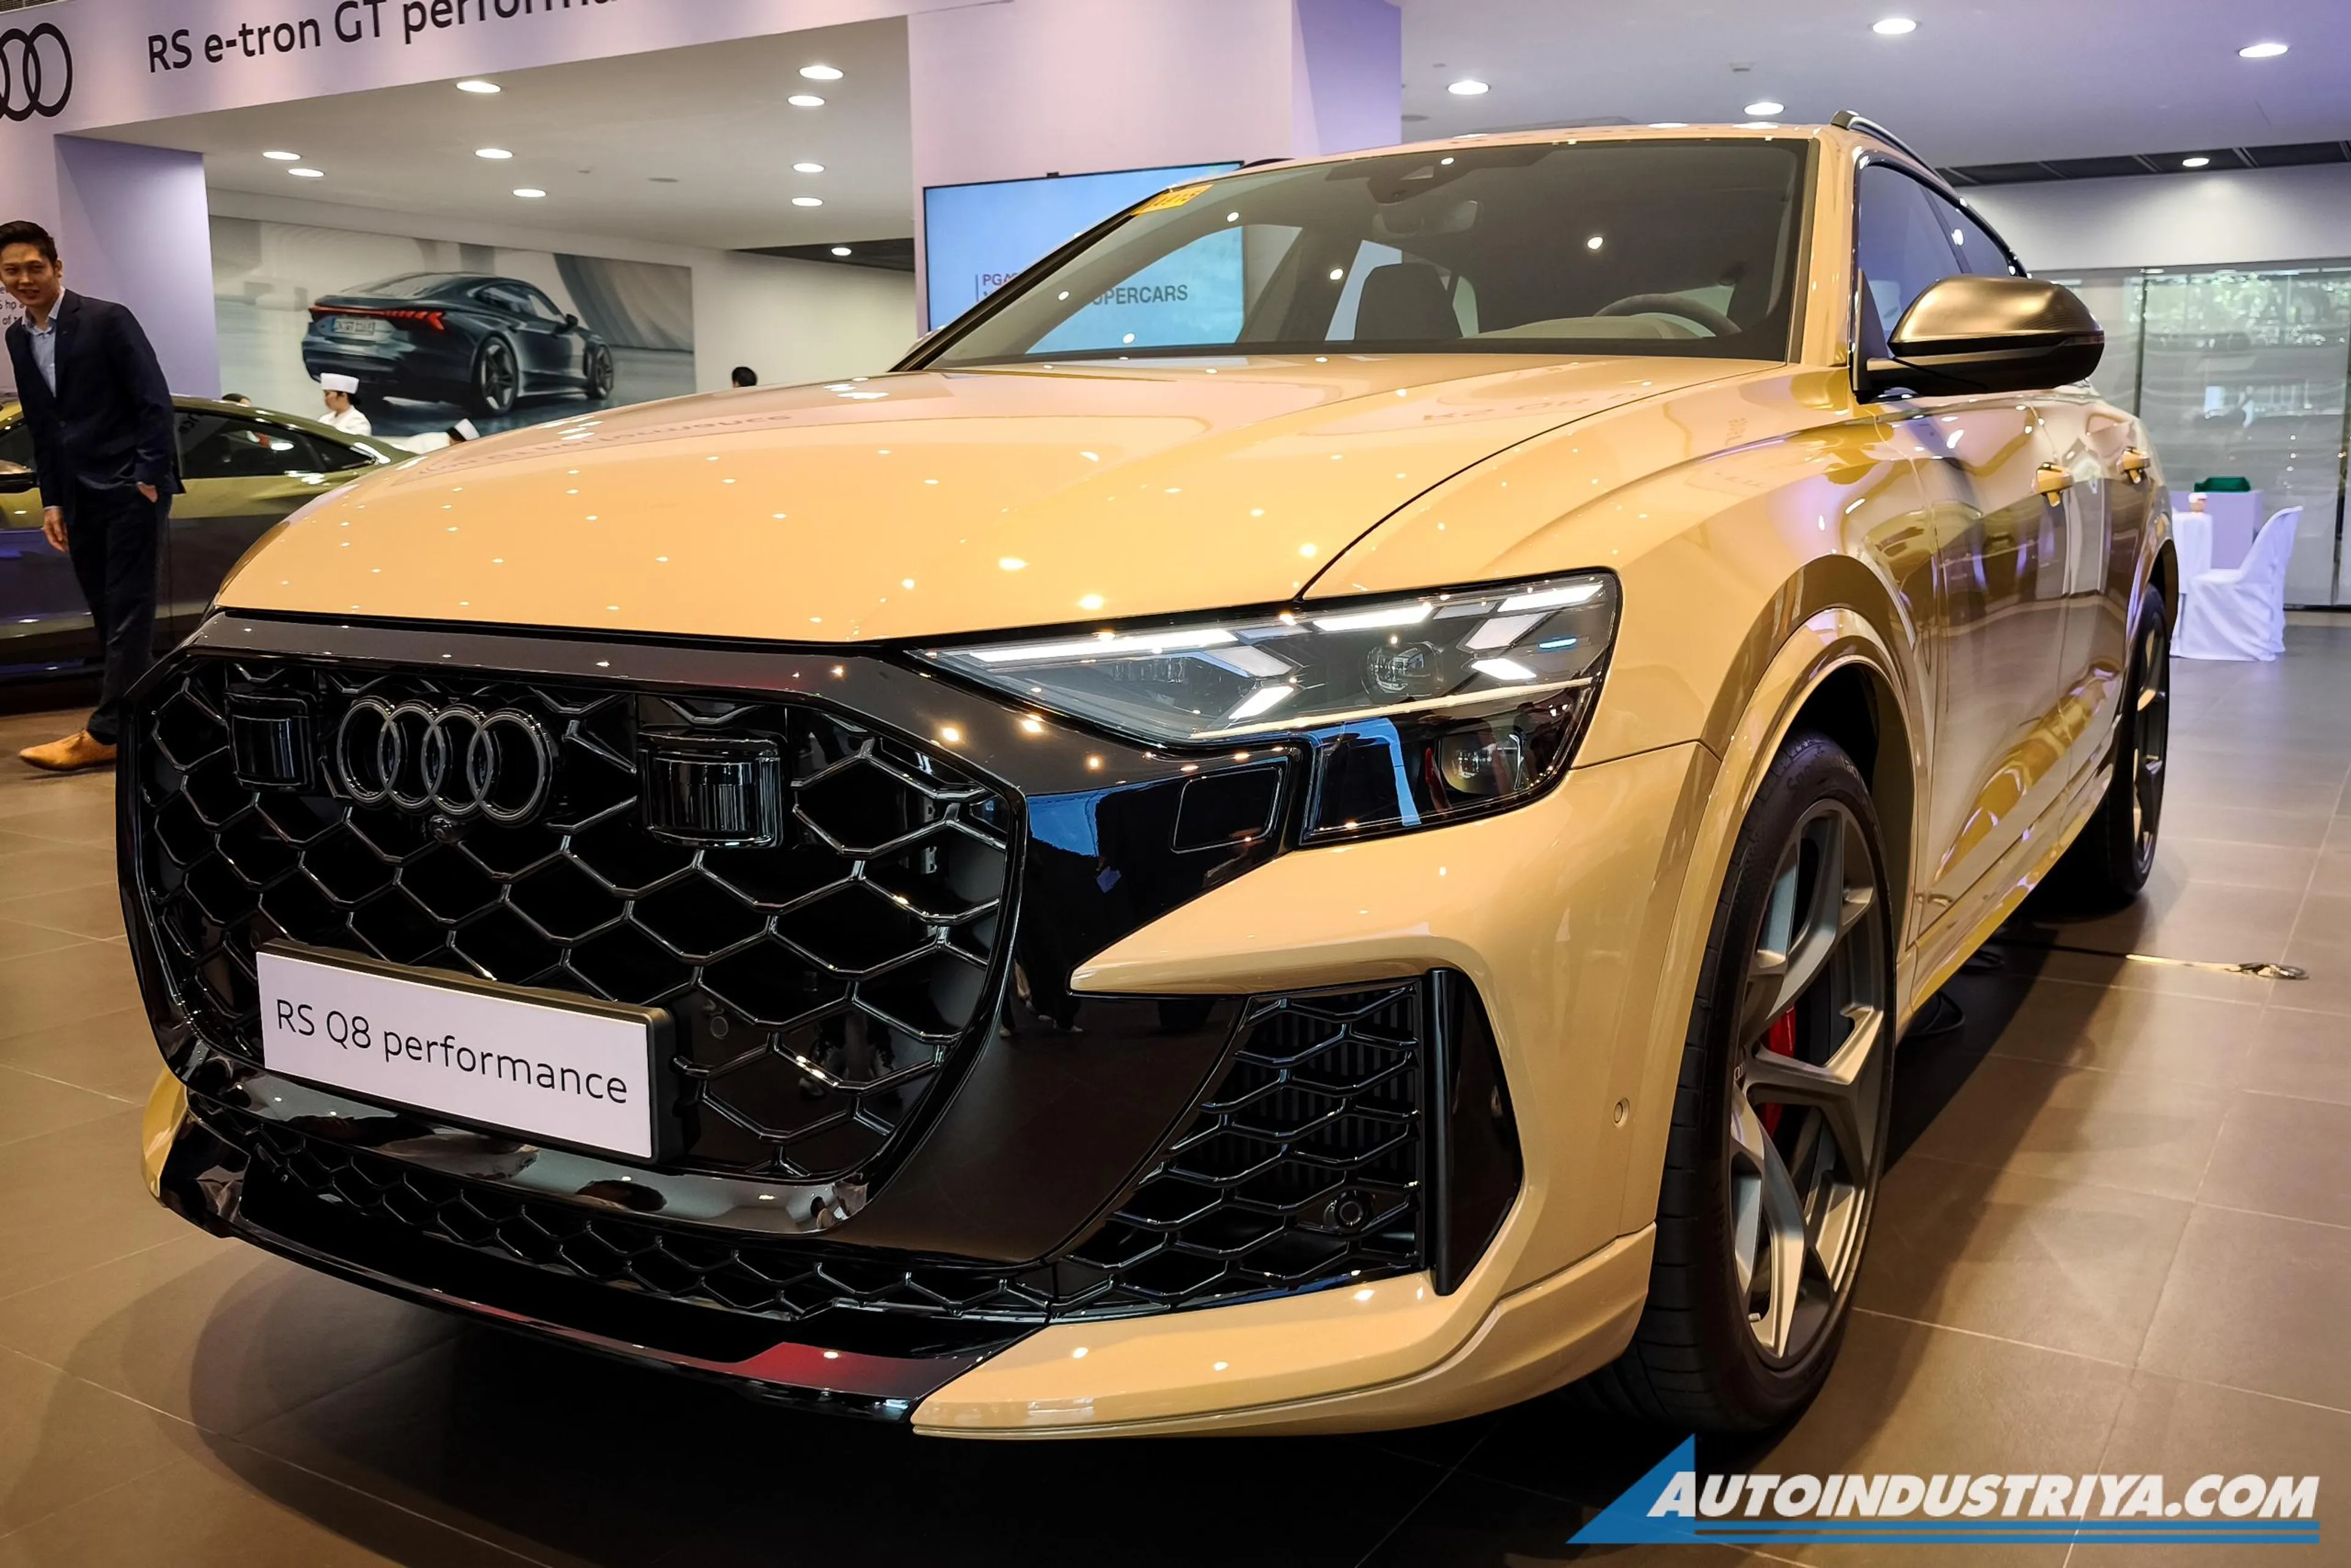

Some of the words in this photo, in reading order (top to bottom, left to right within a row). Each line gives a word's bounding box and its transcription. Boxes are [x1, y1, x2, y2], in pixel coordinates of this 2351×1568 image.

[147, 28, 192, 73] RS
[204, 18, 321, 63] e-tron
[334, 0, 387, 43] GT
[277, 999, 315, 1036] RS
[326, 1010, 371, 1049] Q8
[384, 1031, 627, 1104] performance
